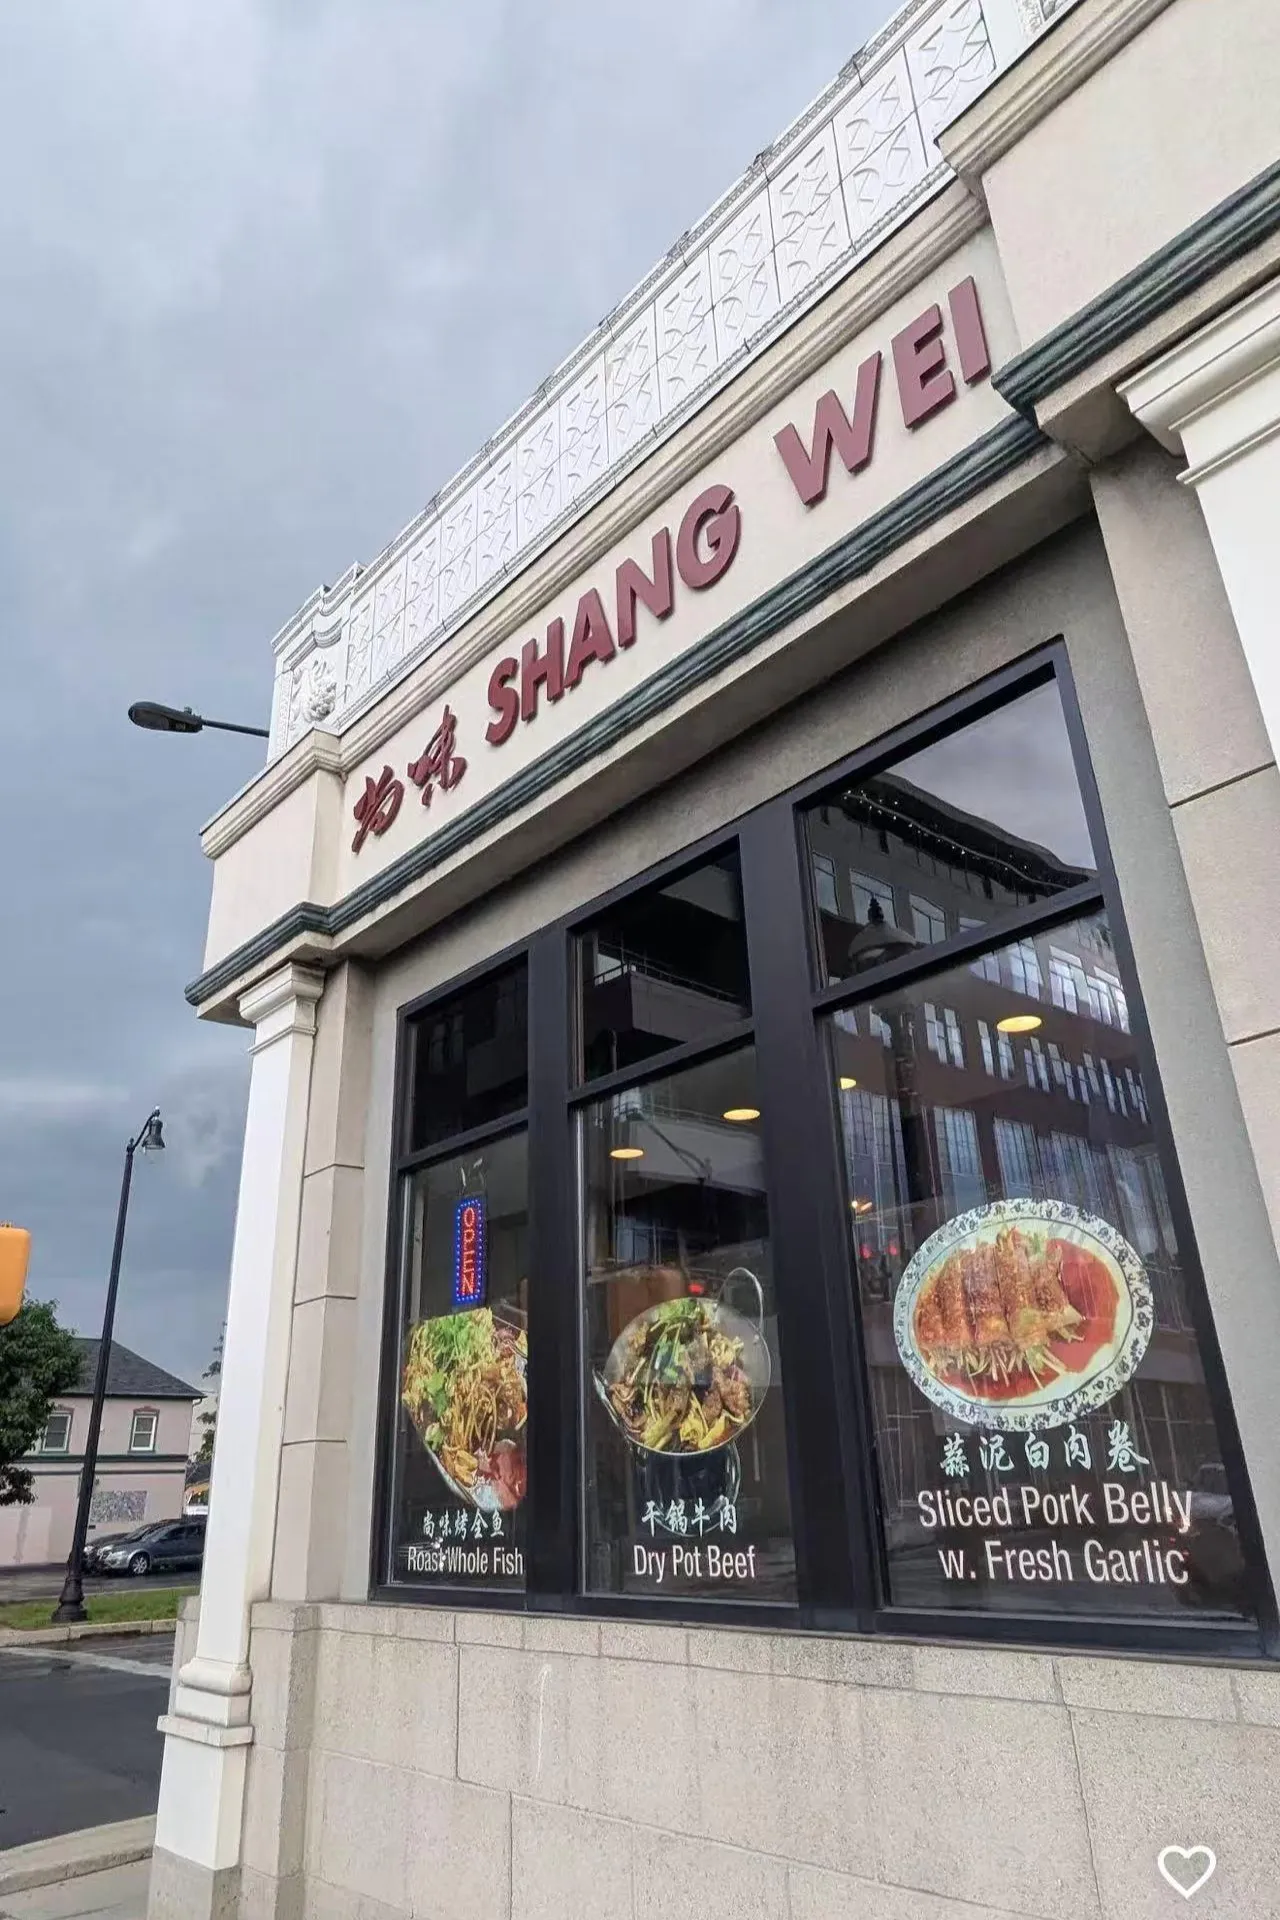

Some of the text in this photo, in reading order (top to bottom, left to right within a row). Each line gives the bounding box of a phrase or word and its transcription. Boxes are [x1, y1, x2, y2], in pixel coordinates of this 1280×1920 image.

[485, 484, 741, 748] SHANG
[773, 275, 990, 506] WEI
[462, 1207, 475, 1296] OPEN
[939, 1420, 1149, 1477] 蒜泥白肉卷
[423, 1507, 505, 1541] 尚味烤全鱼
[917, 1481, 1193, 1533] Sliced Pork Belly
[407, 1546, 524, 1576] Roast Whole Fish
[633, 1544, 756, 1583] Dry Pot Beef
[938, 1538, 1189, 1584] w. Fresh Garlic
